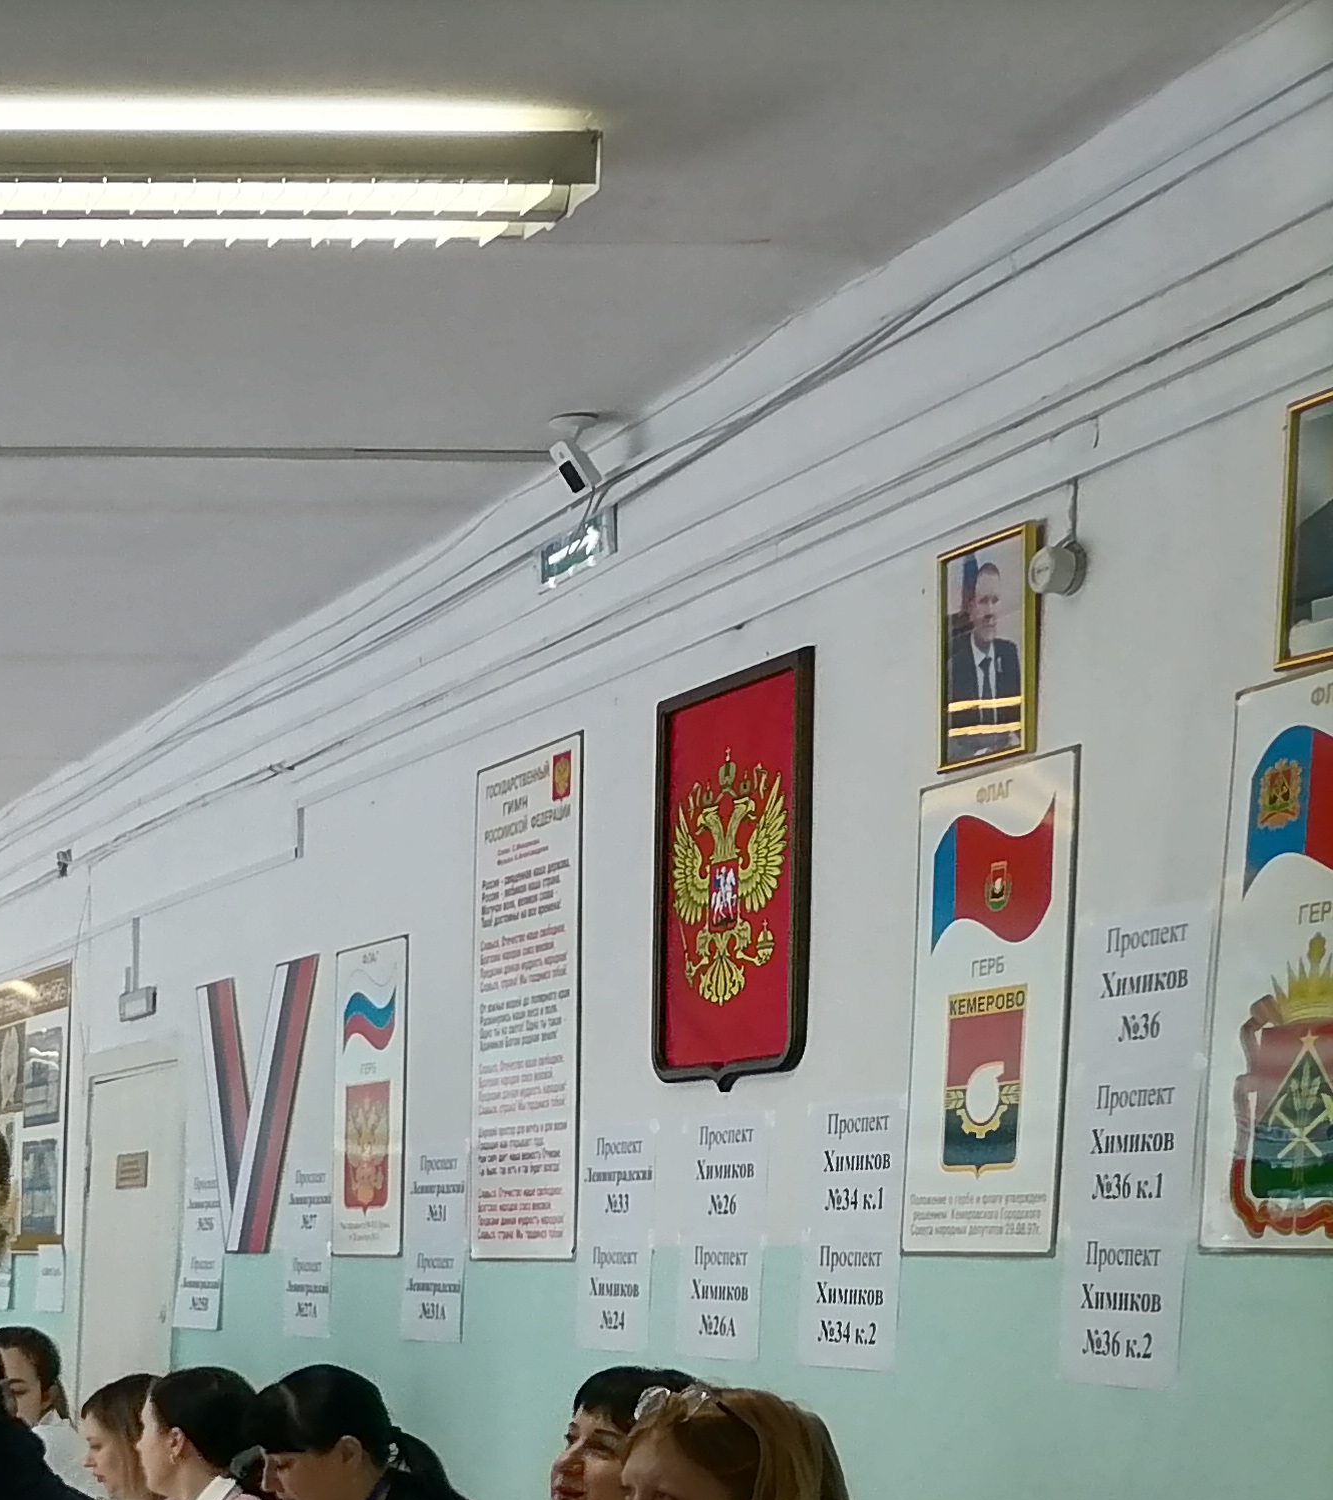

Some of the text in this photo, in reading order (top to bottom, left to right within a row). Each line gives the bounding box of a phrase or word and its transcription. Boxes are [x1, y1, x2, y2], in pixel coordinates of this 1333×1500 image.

[976, 779, 1013, 804] ФЛАГ
[1298, 900, 1333, 925] ГЕР
[1106, 923, 1189, 958] Проспект
[971, 955, 1005, 978] ГЕРБ
[1100, 969, 1188, 999] Химиков
[949, 990, 1026, 1017] КЕМЕРОВО
[1118, 1011, 1161, 1042] №36
[1096, 1085, 1175, 1116] Проспект
[699, 1126, 754, 1150] Проспект
[827, 1113, 890, 1139] Проспект
[596, 1137, 643, 1160] Проспект
[1090, 1129, 1174, 1154] Химиков
[420, 1155, 458, 1175] Проспект
[696, 1159, 754, 1180] Химиков
[823, 1149, 891, 1173] Химиков
[584, 1165, 652, 1186] Ленинградский
[1092, 1173, 1163, 1200] №36 к.1
[410, 1180, 464, 1197] Ленинградский
[824, 1187, 884, 1211] №34 к.1
[426, 1204, 446, 1222] №31
[605, 1194, 629, 1213] №33
[708, 1194, 736, 1215] №26
[417, 1253, 454, 1272] Проспект
[592, 1246, 638, 1269] Проспект
[694, 1245, 748, 1270] Проспект
[820, 1245, 883, 1272] Проспект
[1086, 1241, 1161, 1272] Проспект
[405, 1278, 460, 1296] Ленинградский
[589, 1277, 639, 1298] Химиков
[691, 1278, 748, 1301] Химиков
[816, 1281, 883, 1305] Химиков
[1081, 1283, 1162, 1312] Химиков
[600, 1310, 625, 1331] №24
[699, 1314, 736, 1337] №26А
[817, 1320, 877, 1345] №34 к.2
[1083, 1329, 1152, 1359] №36 к.2
